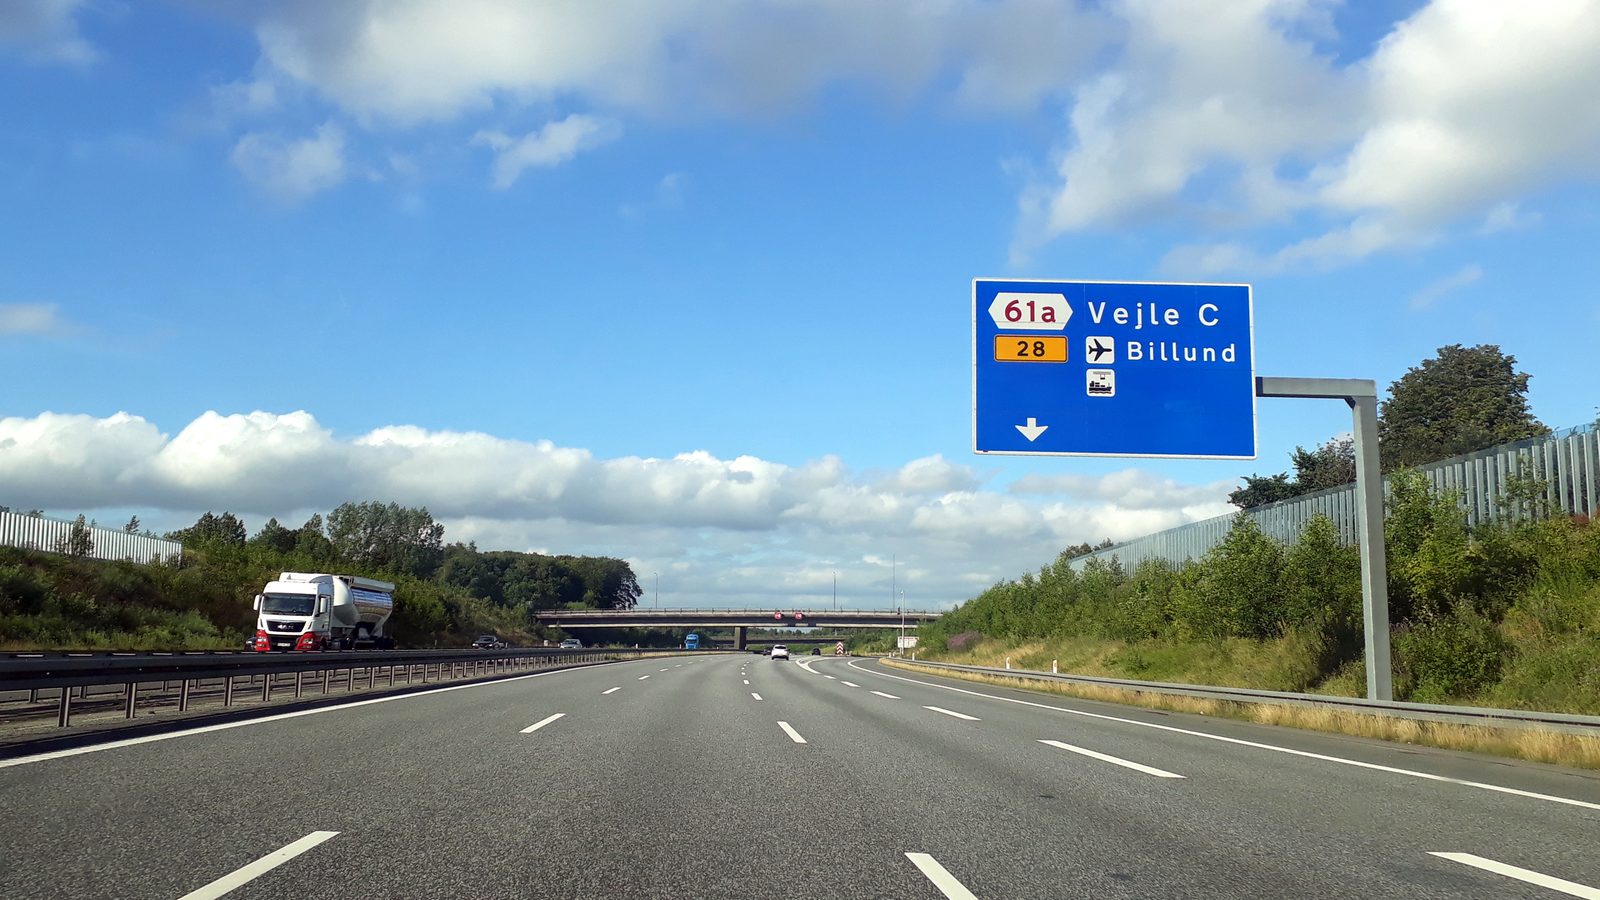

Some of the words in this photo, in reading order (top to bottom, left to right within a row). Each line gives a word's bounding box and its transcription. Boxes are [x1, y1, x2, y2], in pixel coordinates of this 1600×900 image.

[1004, 299, 1057, 323] 61a
[1087, 301, 1180, 330] Vejle
[1198, 303, 1219, 327] C
[1017, 340, 1046, 357] 28
[1127, 341, 1236, 363] Billund
